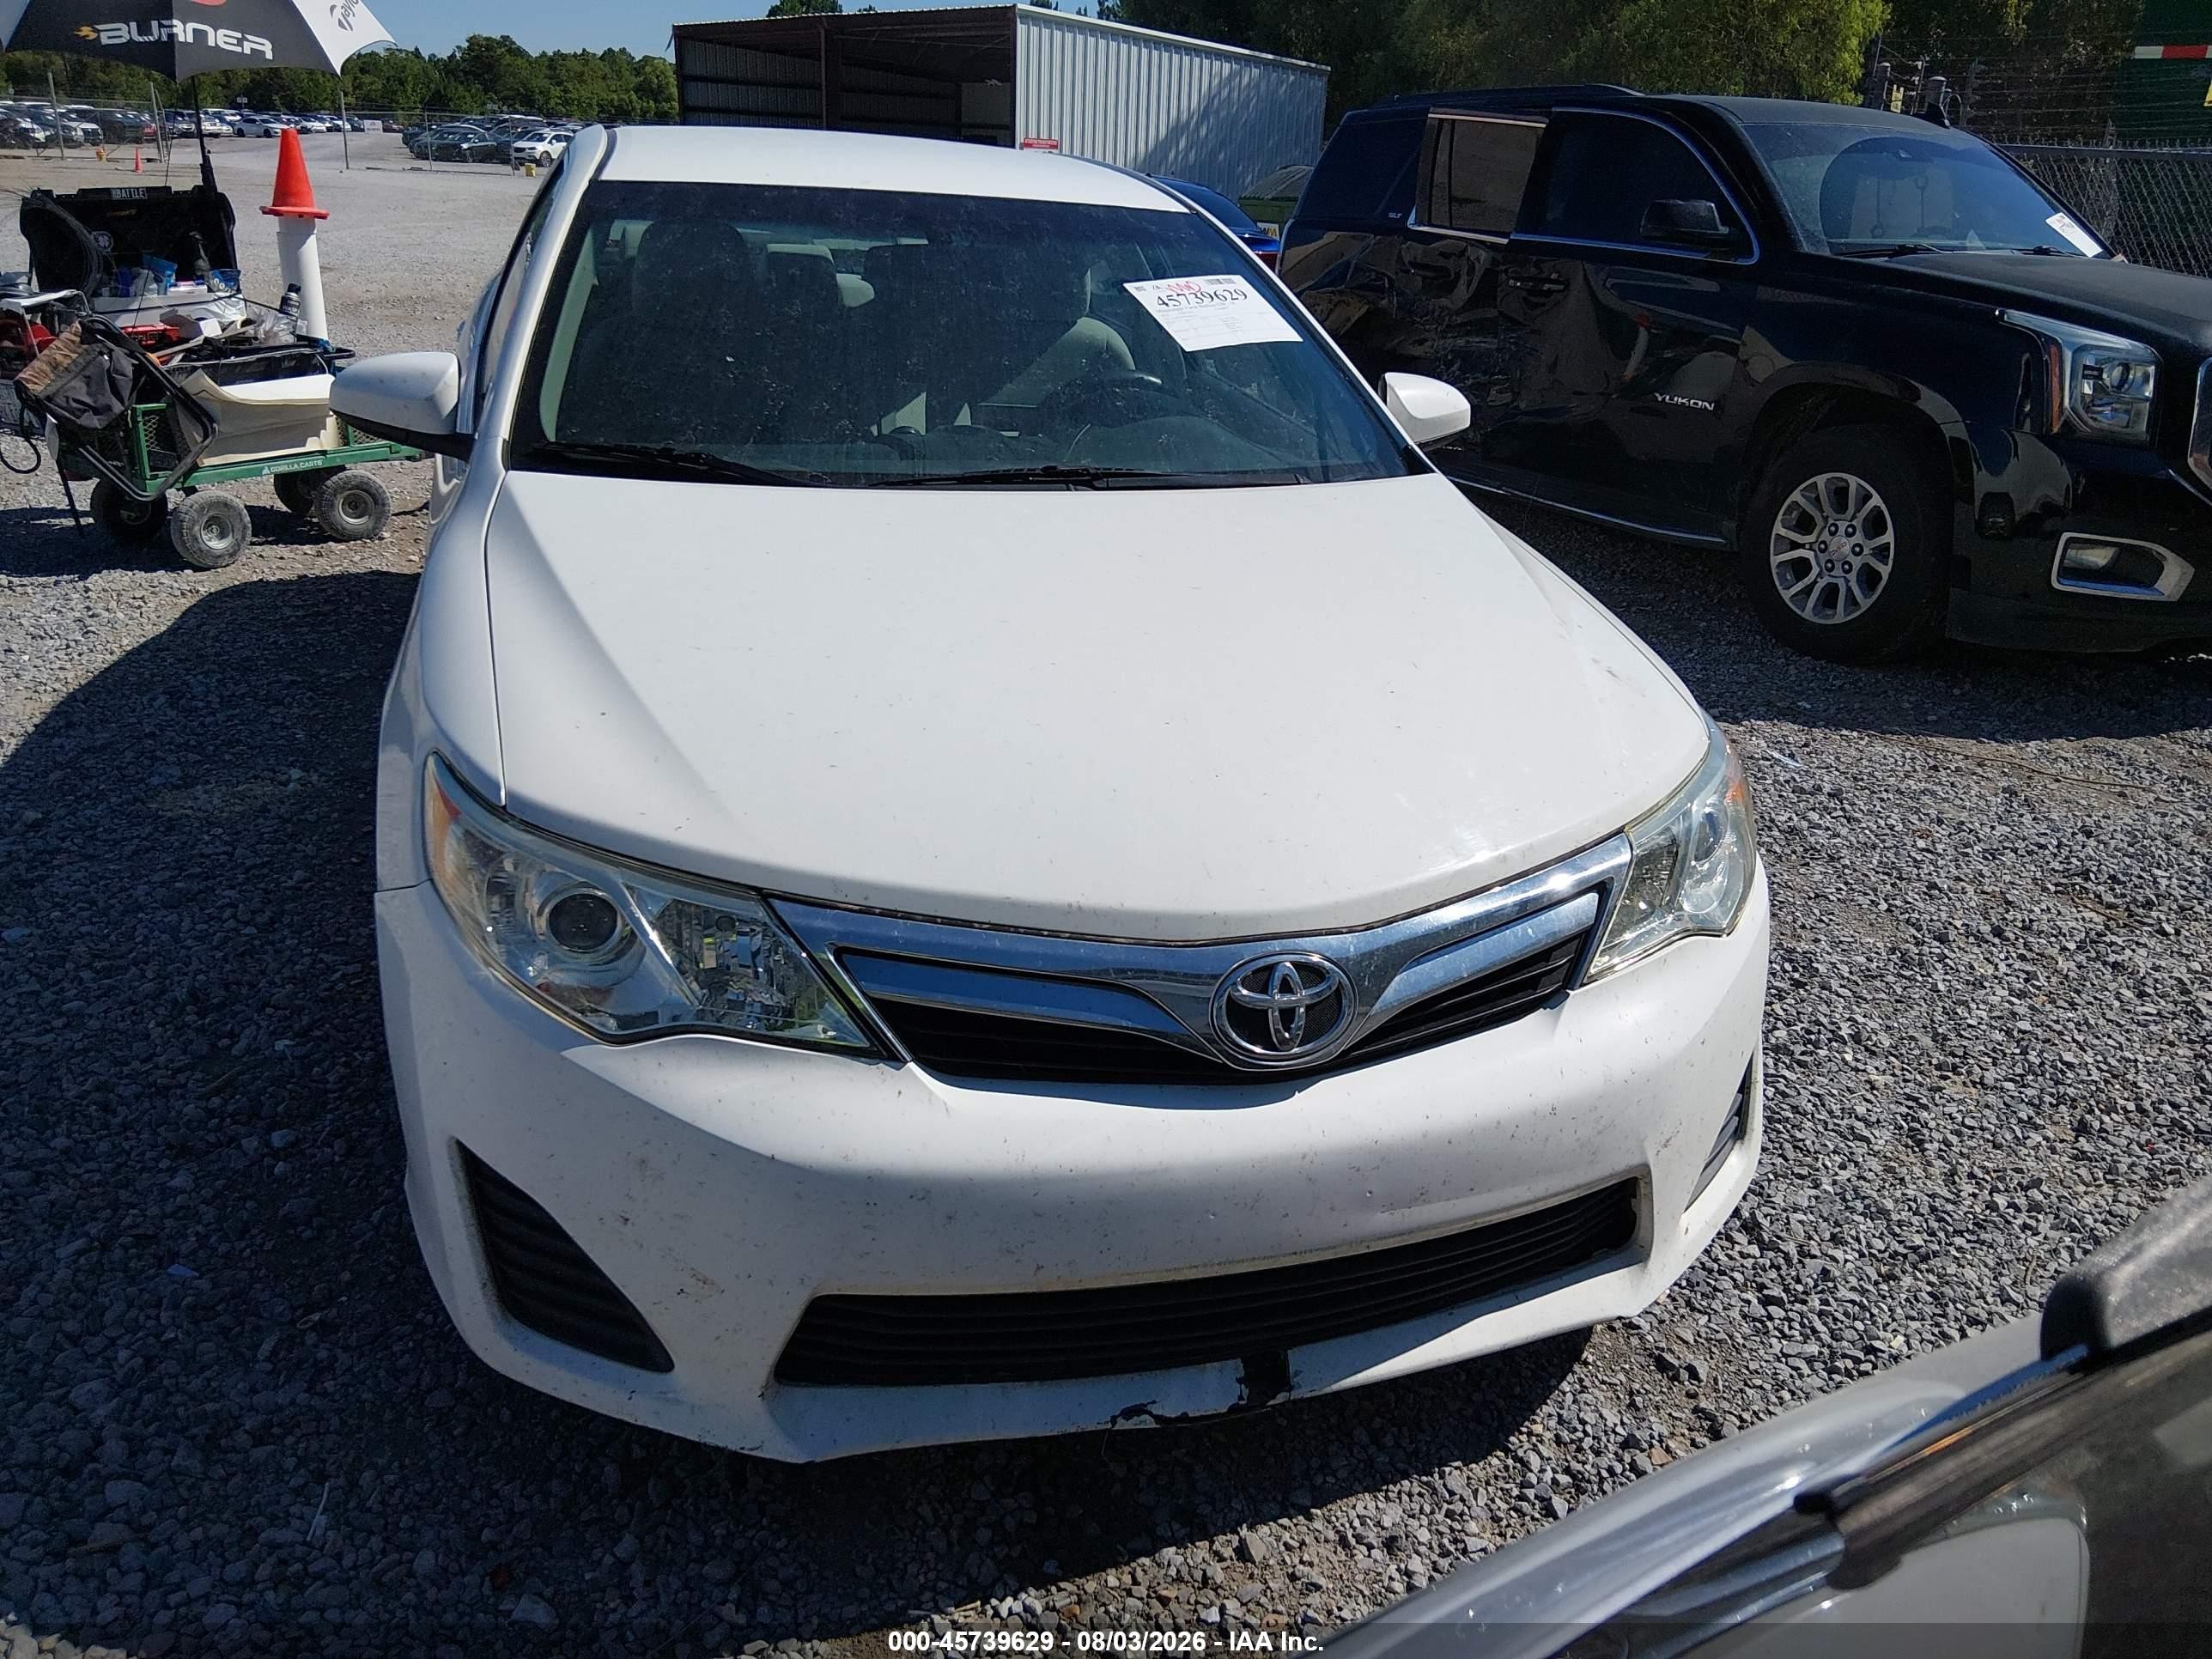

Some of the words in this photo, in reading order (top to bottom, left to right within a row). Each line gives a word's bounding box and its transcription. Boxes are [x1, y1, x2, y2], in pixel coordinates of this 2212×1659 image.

[94, 19, 273, 60] BURNER
[117, 188, 145, 198] BATTLE
[1157, 289, 1248, 307] 45739629
[1654, 392, 1715, 410] YUKON
[270, 463, 299, 473] GORILLA
[300, 459, 323, 468] CARTS
